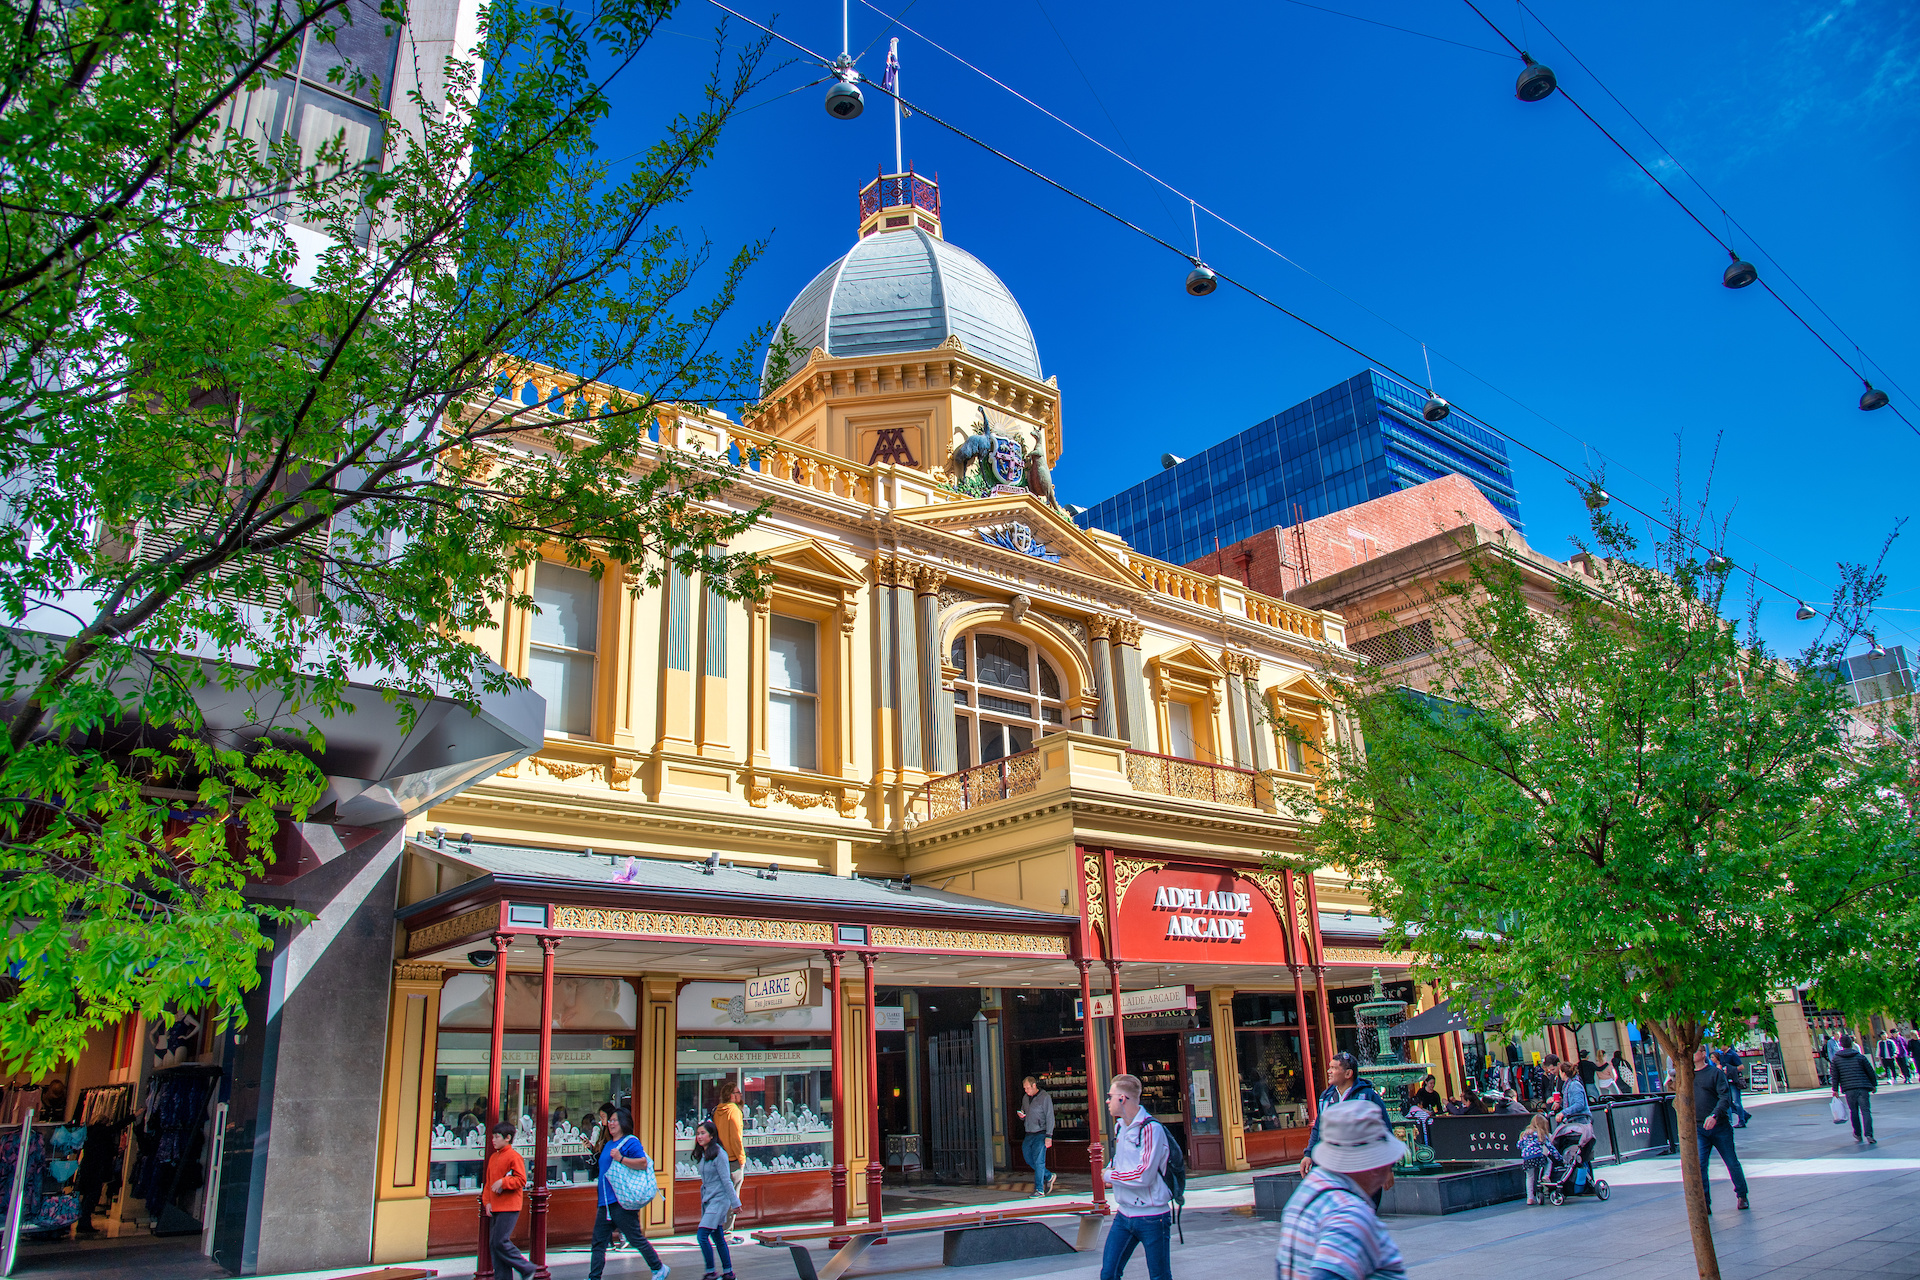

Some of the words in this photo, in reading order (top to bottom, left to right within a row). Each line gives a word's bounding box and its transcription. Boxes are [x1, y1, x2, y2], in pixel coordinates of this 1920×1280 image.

[941, 552, 1026, 585] ADELAIDE
[1038, 579, 1098, 605] ARCADE
[1153, 886, 1252, 913] ADELAIDE
[1166, 915, 1246, 940] ARCADE
[749, 977, 790, 998] CLARKE
[1106, 995, 1146, 1009] ALAIDE
[1147, 991, 1181, 1004] ARCADE
[1336, 993, 1361, 1004] KOKO
[550, 1052, 592, 1061] EWELLER
[713, 1053, 744, 1061] CLARKE
[764, 1052, 801, 1061] JEWELLER
[1630, 1116, 1648, 1126] KOKO
[1470, 1132, 1507, 1141] KOKO
[1632, 1127, 1650, 1136] BLACK
[764, 1135, 802, 1145] JEWELLER
[1470, 1143, 1509, 1152] BLACK
